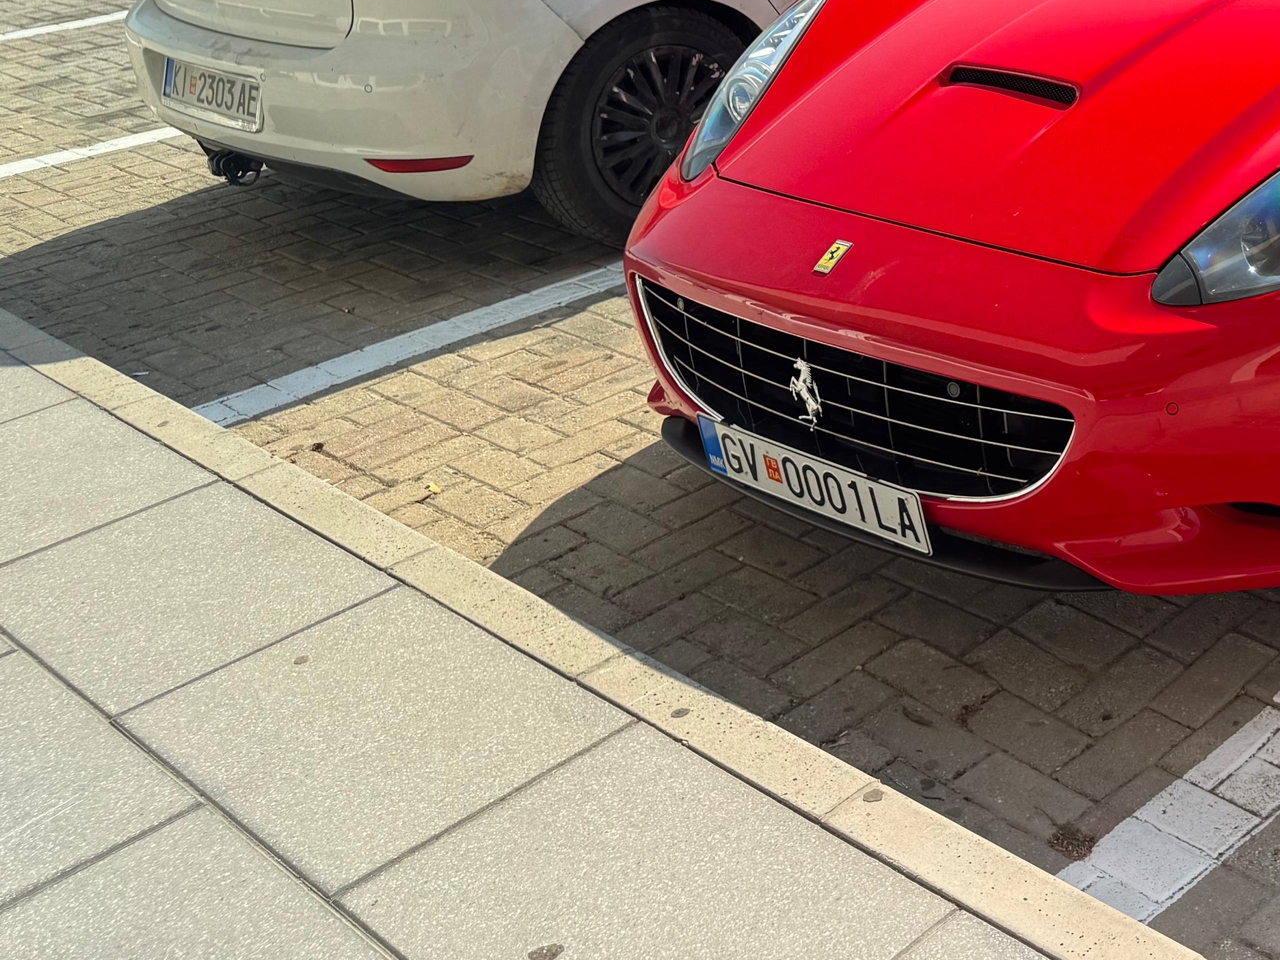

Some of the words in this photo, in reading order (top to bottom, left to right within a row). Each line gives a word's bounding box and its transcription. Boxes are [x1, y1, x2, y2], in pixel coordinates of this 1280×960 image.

[172, 65, 187, 98] KI
[196, 72, 236, 111] 2303
[721, 433, 758, 482] GV
